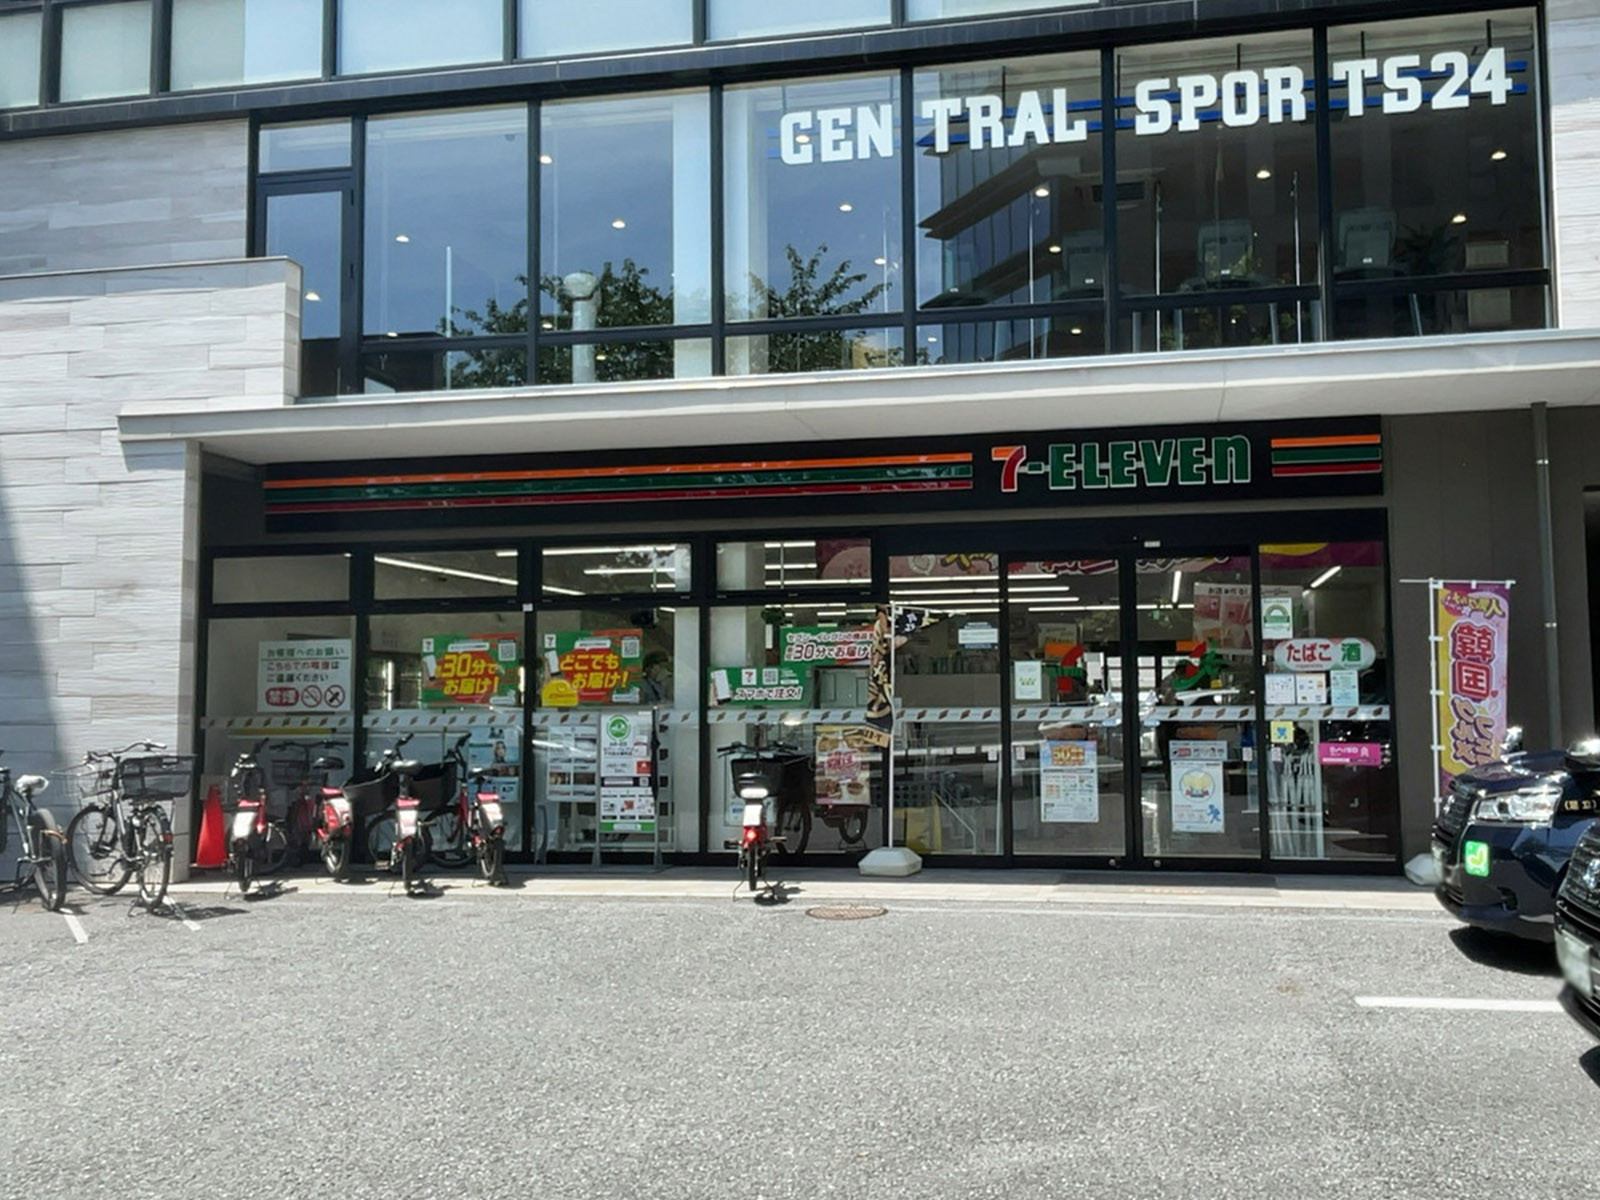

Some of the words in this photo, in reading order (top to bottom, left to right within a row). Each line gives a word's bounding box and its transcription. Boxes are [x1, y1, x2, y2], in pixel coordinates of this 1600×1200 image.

[560, 653, 620, 671] どこでも
[1286, 642, 1332, 663] たばこ
[1341, 642, 1361, 662] 酒
